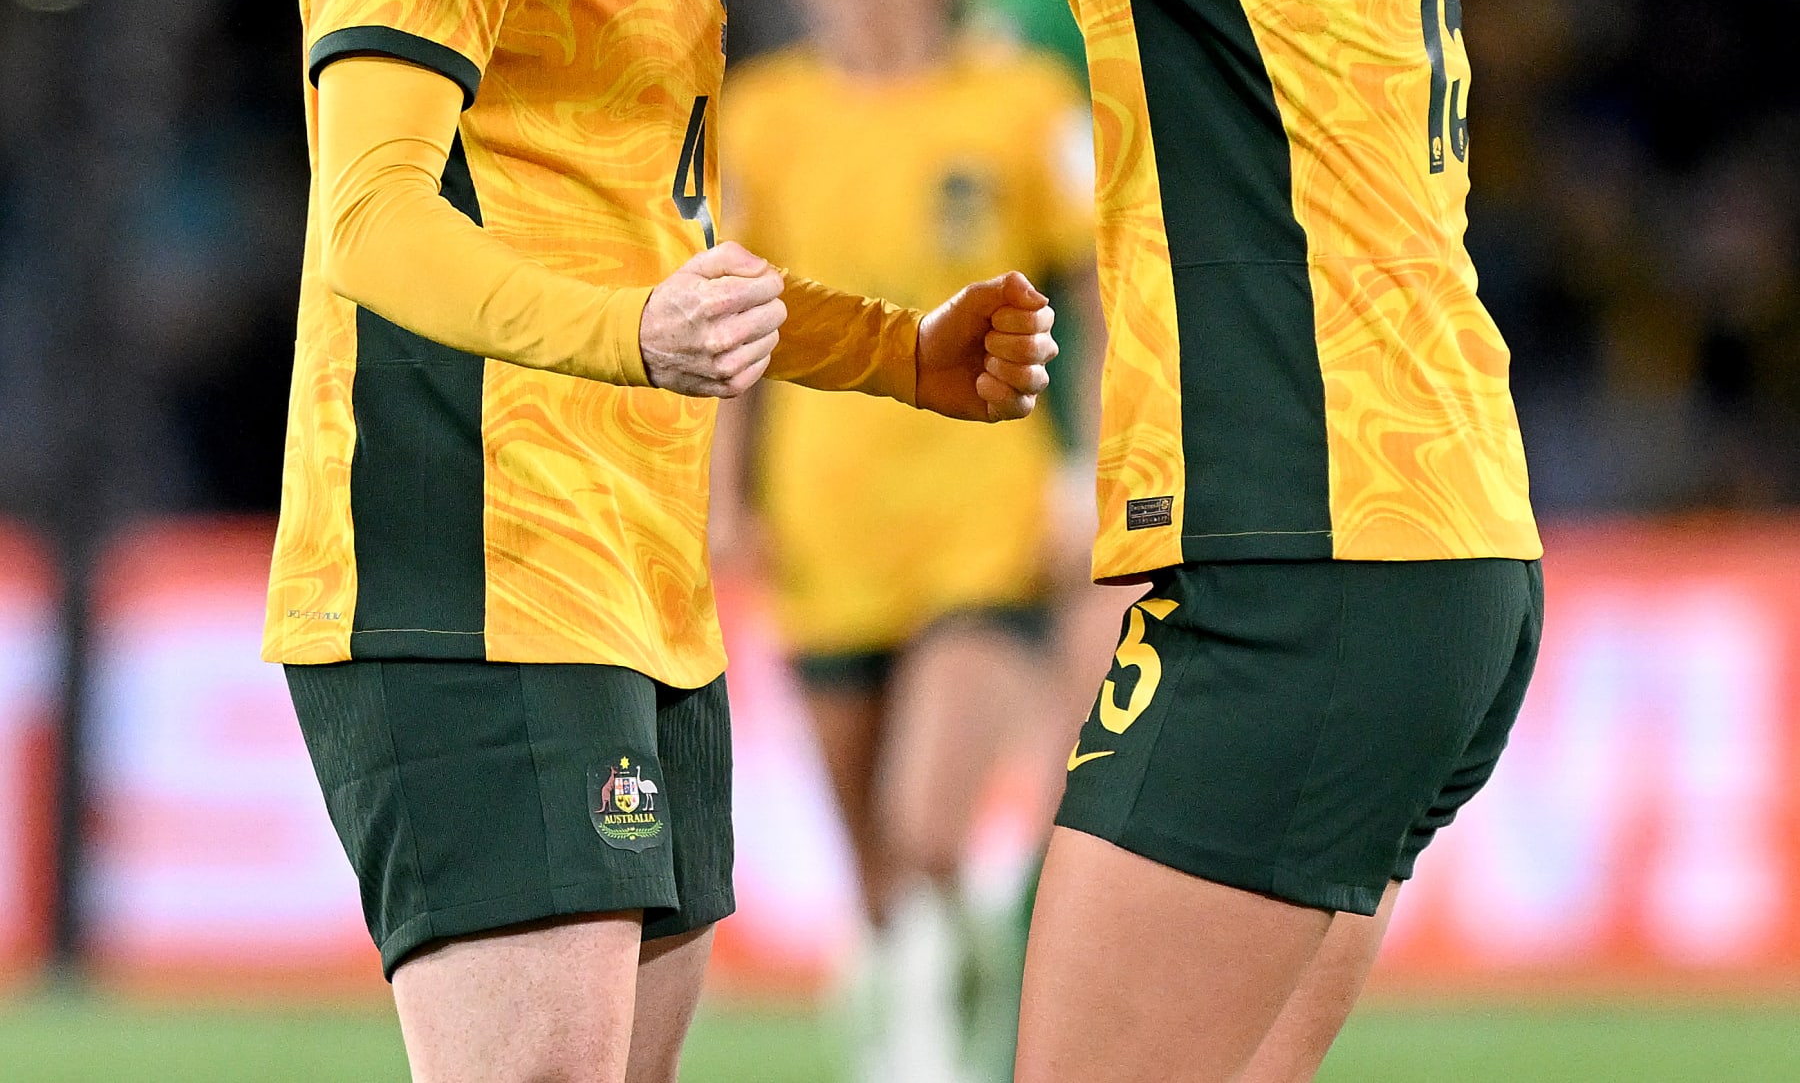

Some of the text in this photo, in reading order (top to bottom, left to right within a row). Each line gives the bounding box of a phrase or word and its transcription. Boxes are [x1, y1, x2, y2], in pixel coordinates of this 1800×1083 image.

[672, 95, 715, 250] 4
[1098, 598, 1181, 735] 5
[604, 813, 656, 824] AUSTRALIA
